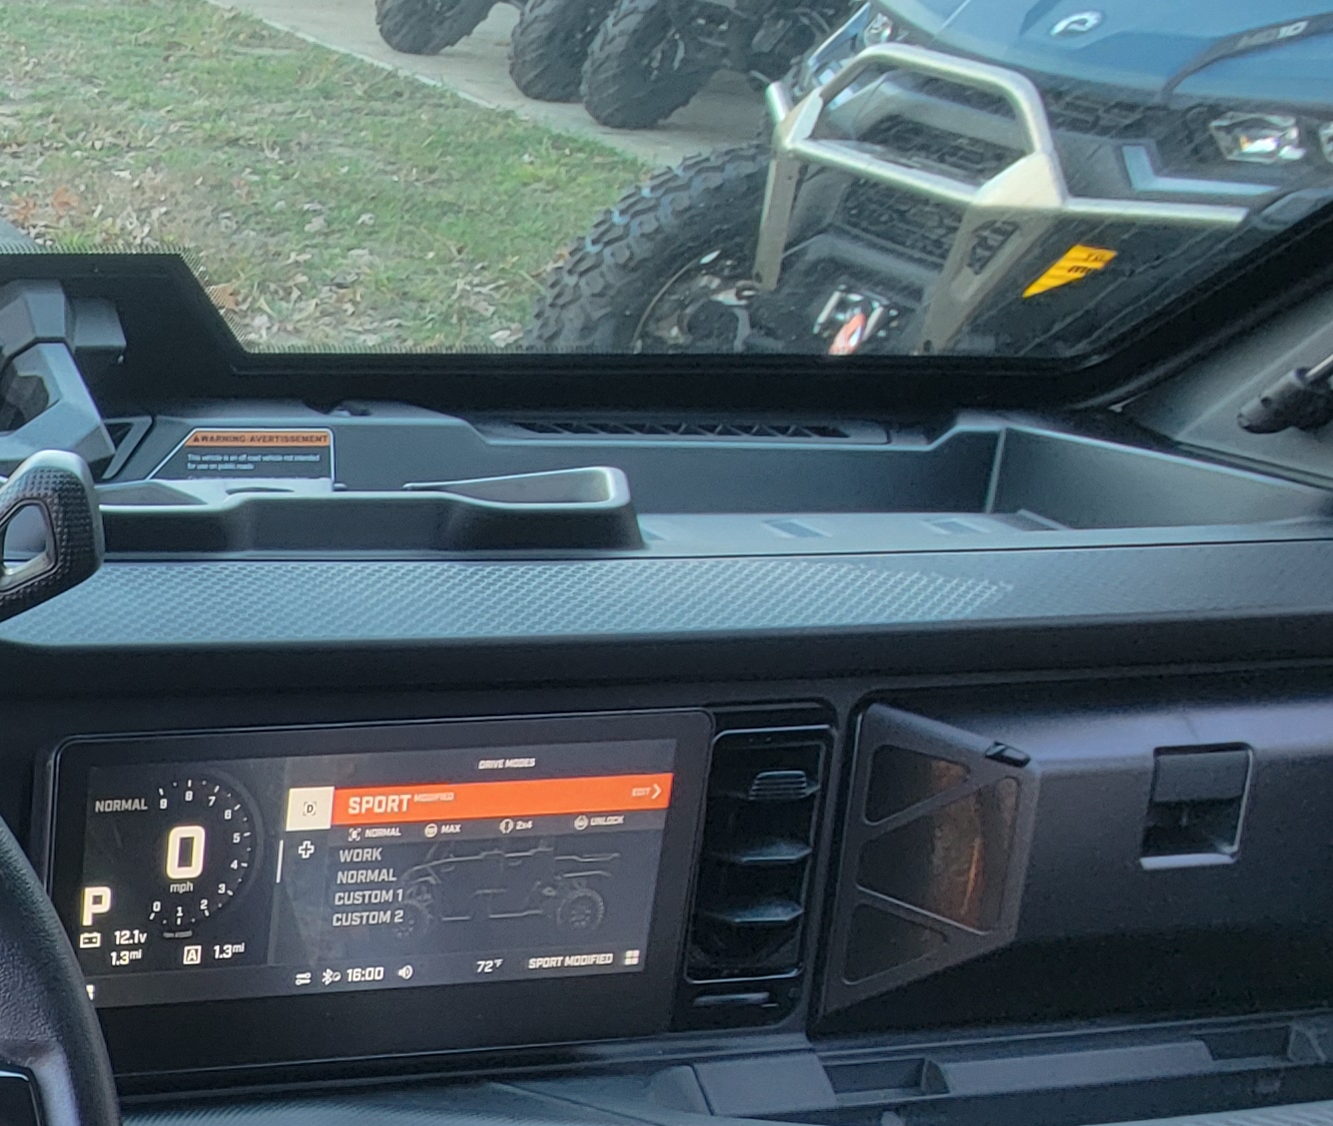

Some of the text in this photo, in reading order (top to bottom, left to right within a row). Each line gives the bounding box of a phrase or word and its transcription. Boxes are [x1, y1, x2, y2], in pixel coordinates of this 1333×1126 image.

[201, 434, 328, 443] WARNING AVERTISSEMENT
[478, 757, 536, 770] DRIVE MODES
[185, 791, 193, 801] 8
[208, 795, 217, 807] 7
[94, 798, 149, 813] NORMAL
[348, 792, 455, 815] SPORT MODIFIED
[224, 809, 232, 820] 6
[590, 815, 625, 826] UNLOCK
[364, 827, 401, 838] NORMAL
[441, 824, 461, 834] MAX
[233, 832, 241, 844] 5
[166, 825, 206, 879] 0
[339, 847, 383, 863] WORK
[230, 859, 238, 870] 4
[337, 868, 398, 884] NORMAL
[169, 881, 193, 894] mph
[218, 883, 226, 894] 3
[334, 888, 404, 906] CUSTOM 1
[82, 886, 112, 927] P
[152, 901, 161, 912] 0
[200, 899, 208, 910] 2
[177, 906, 183, 917] 1
[332, 909, 404, 927] CUSTOM 2
[114, 929, 148, 945] 12.1v
[186, 949, 198, 962] A
[528, 953, 614, 969] SPORT MODIFIED
